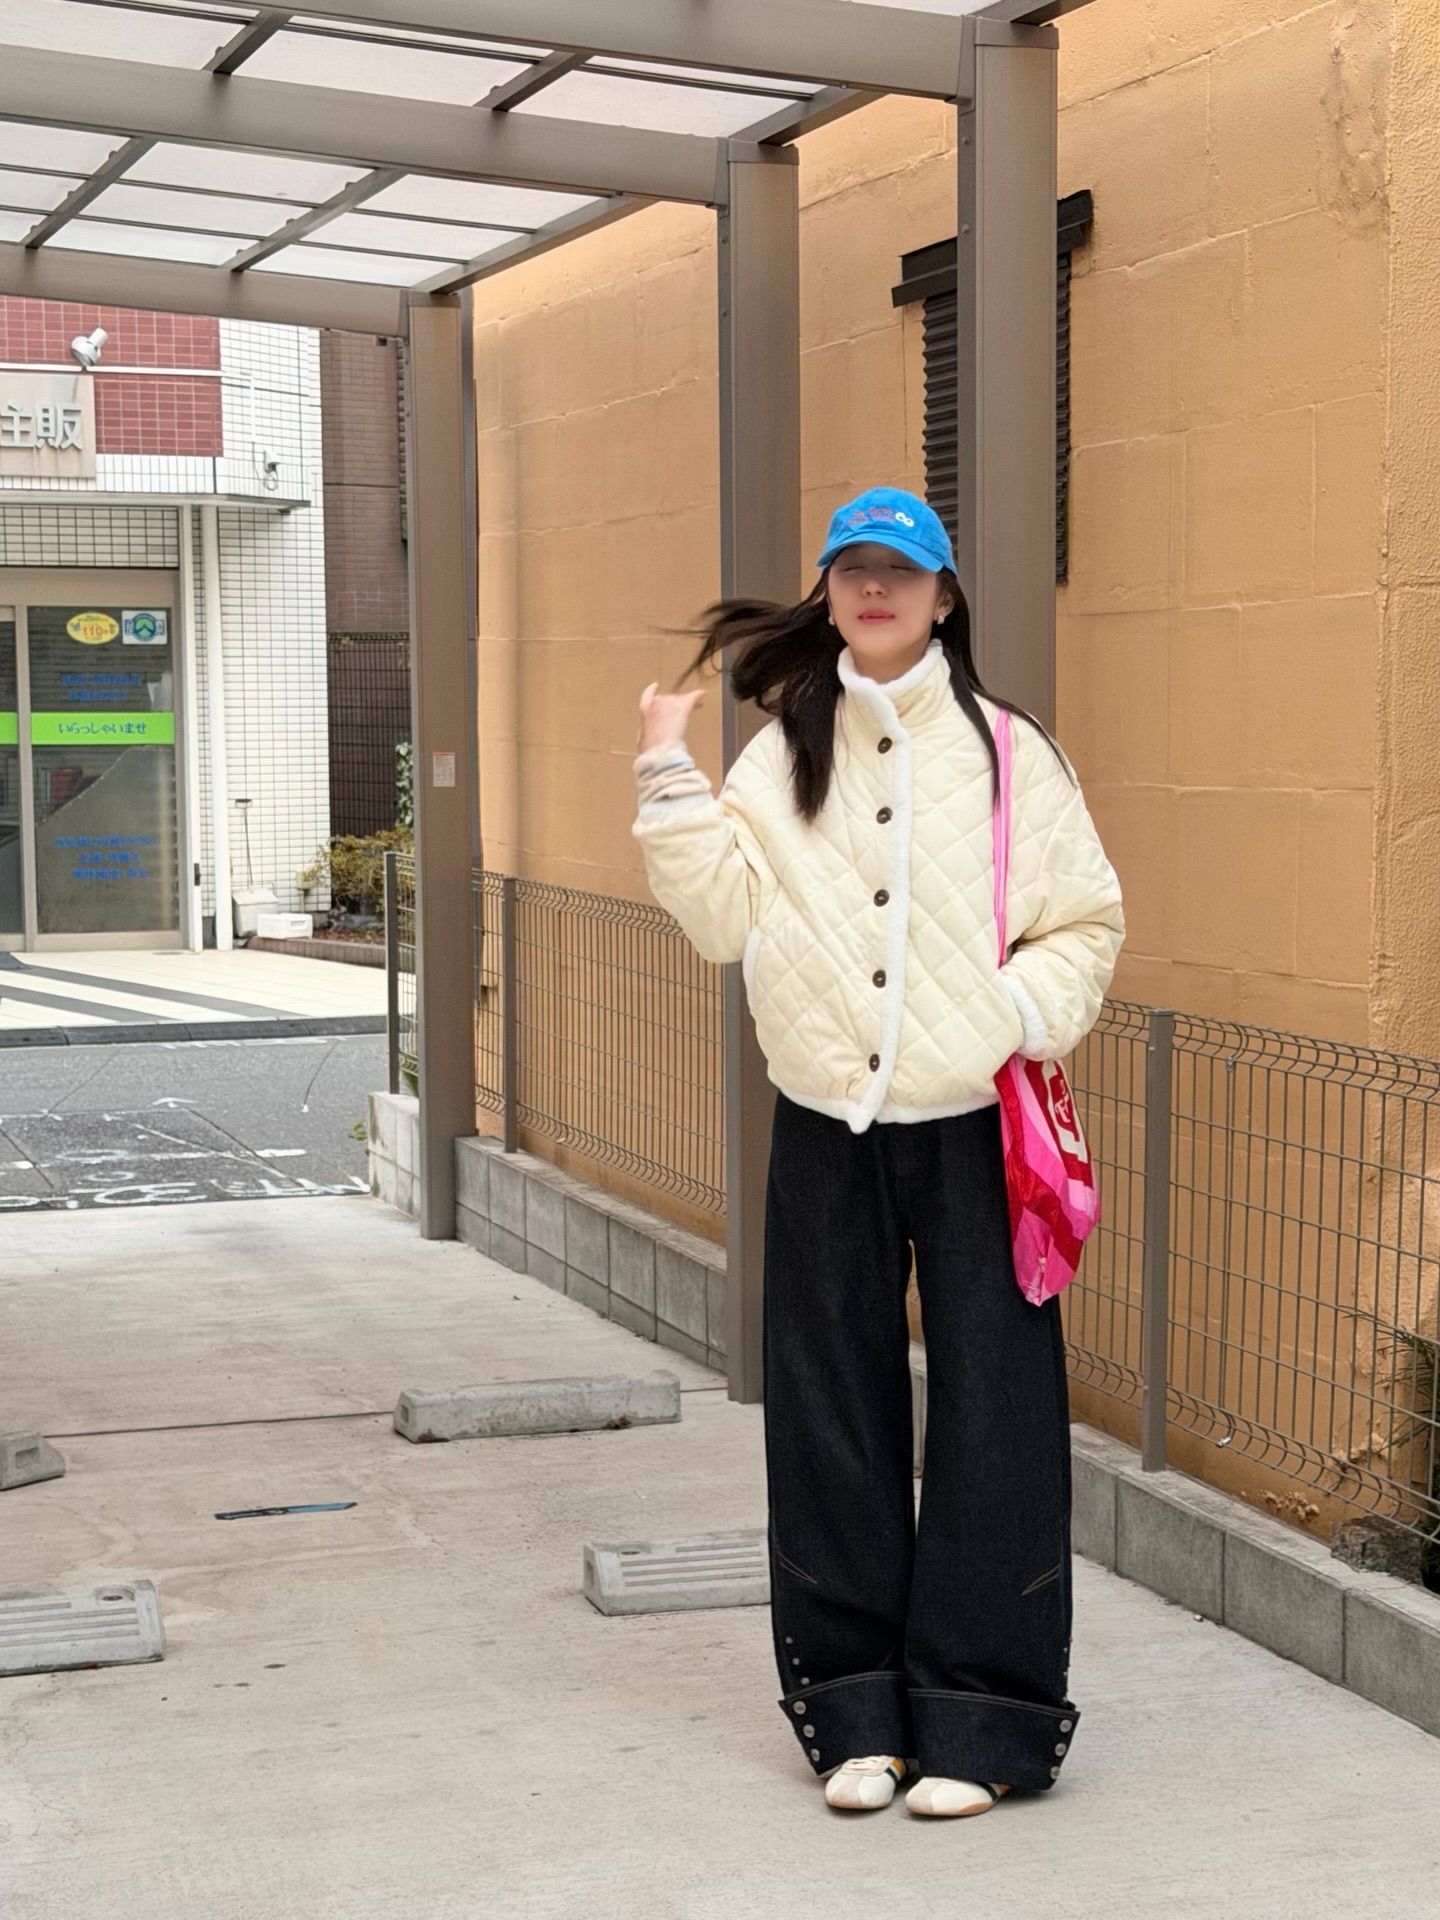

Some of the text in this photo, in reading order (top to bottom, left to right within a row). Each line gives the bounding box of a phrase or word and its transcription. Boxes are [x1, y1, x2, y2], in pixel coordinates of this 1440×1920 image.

[58, 721, 147, 735] いらっしゃいませ
